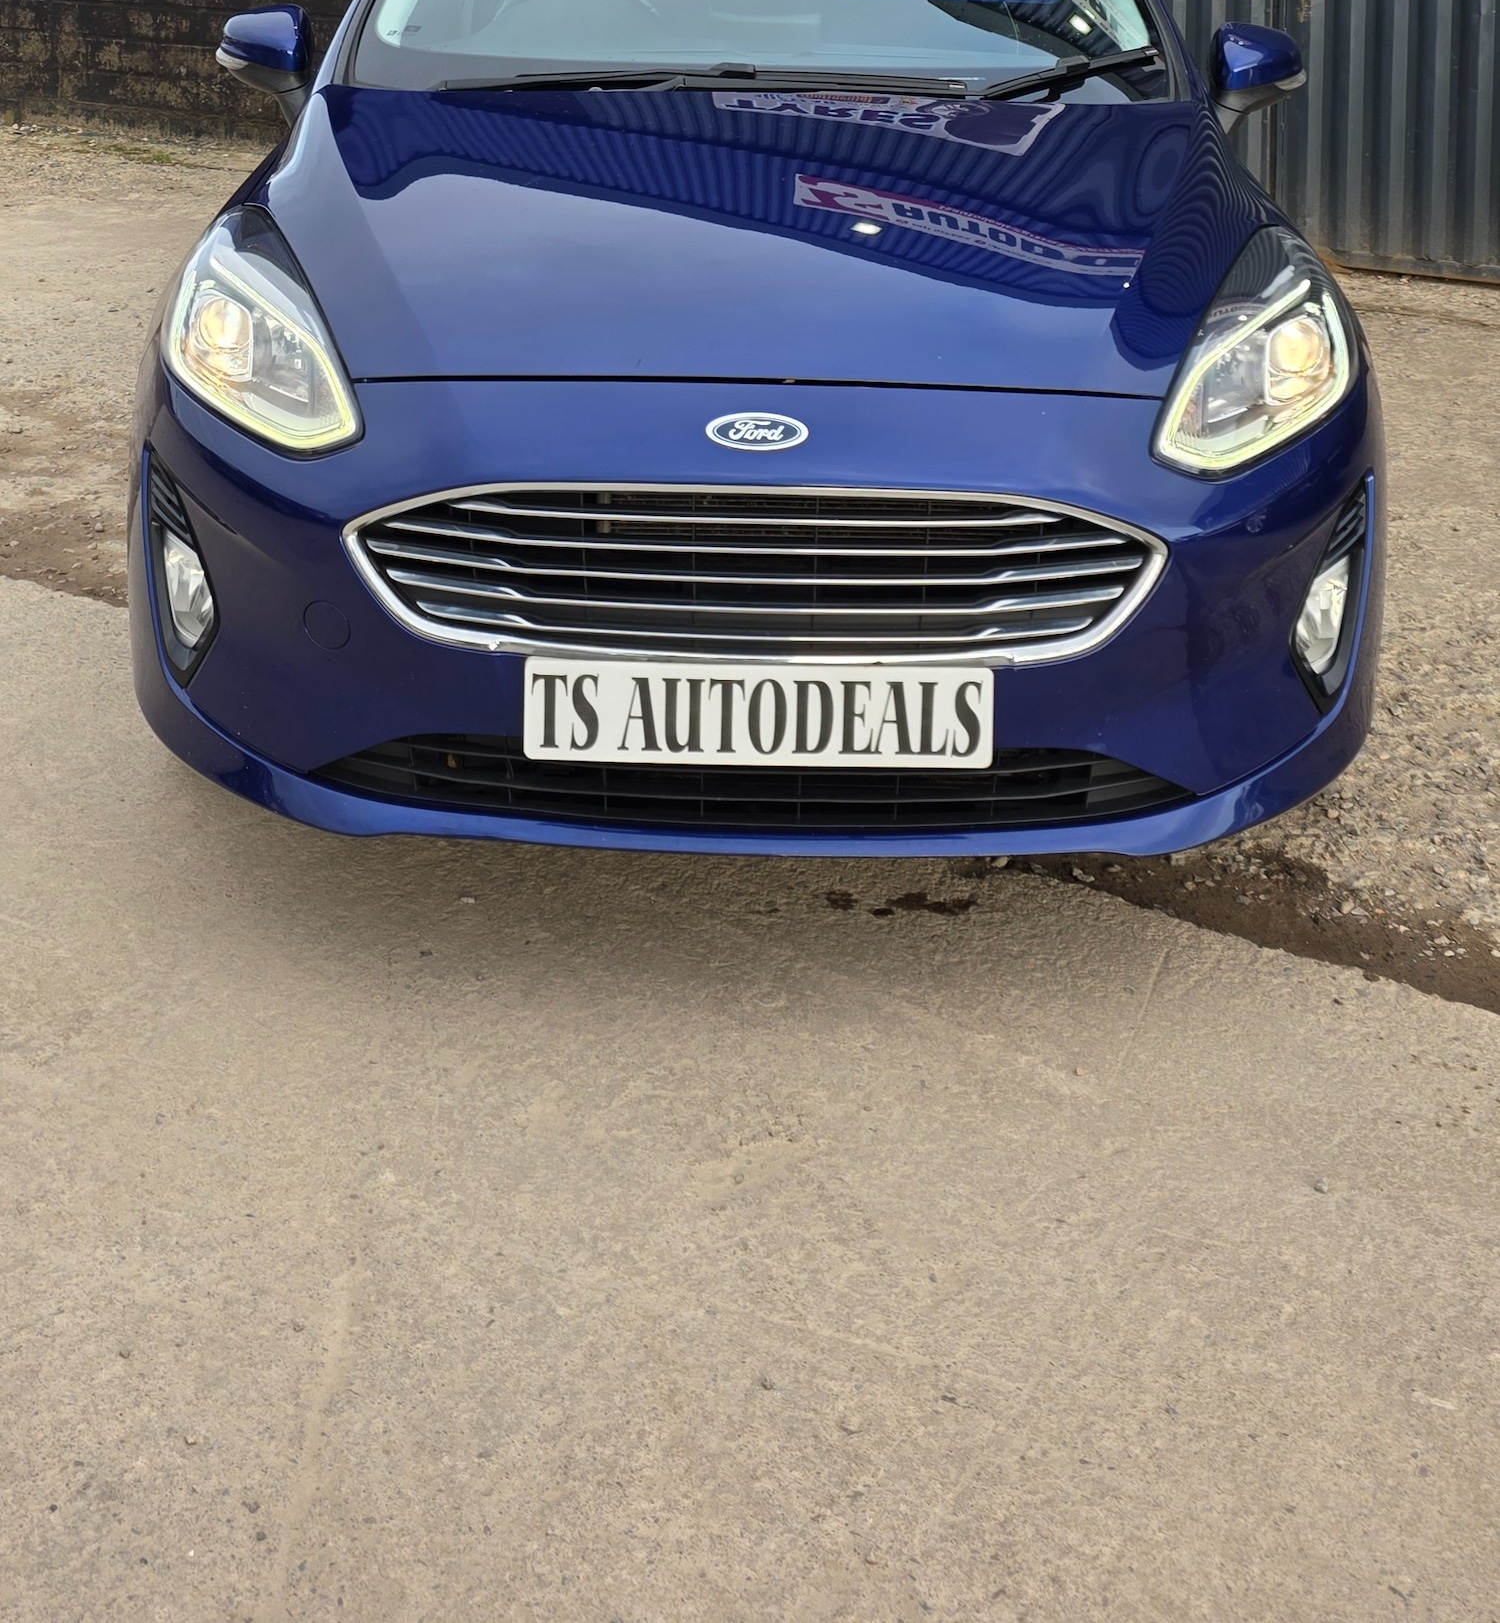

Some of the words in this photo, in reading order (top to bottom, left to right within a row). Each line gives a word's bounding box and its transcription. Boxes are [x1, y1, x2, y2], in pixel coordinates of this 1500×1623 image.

[728, 419, 784, 443] Ford
[531, 673, 599, 751] TS
[617, 676, 984, 758] AUTODEALS
